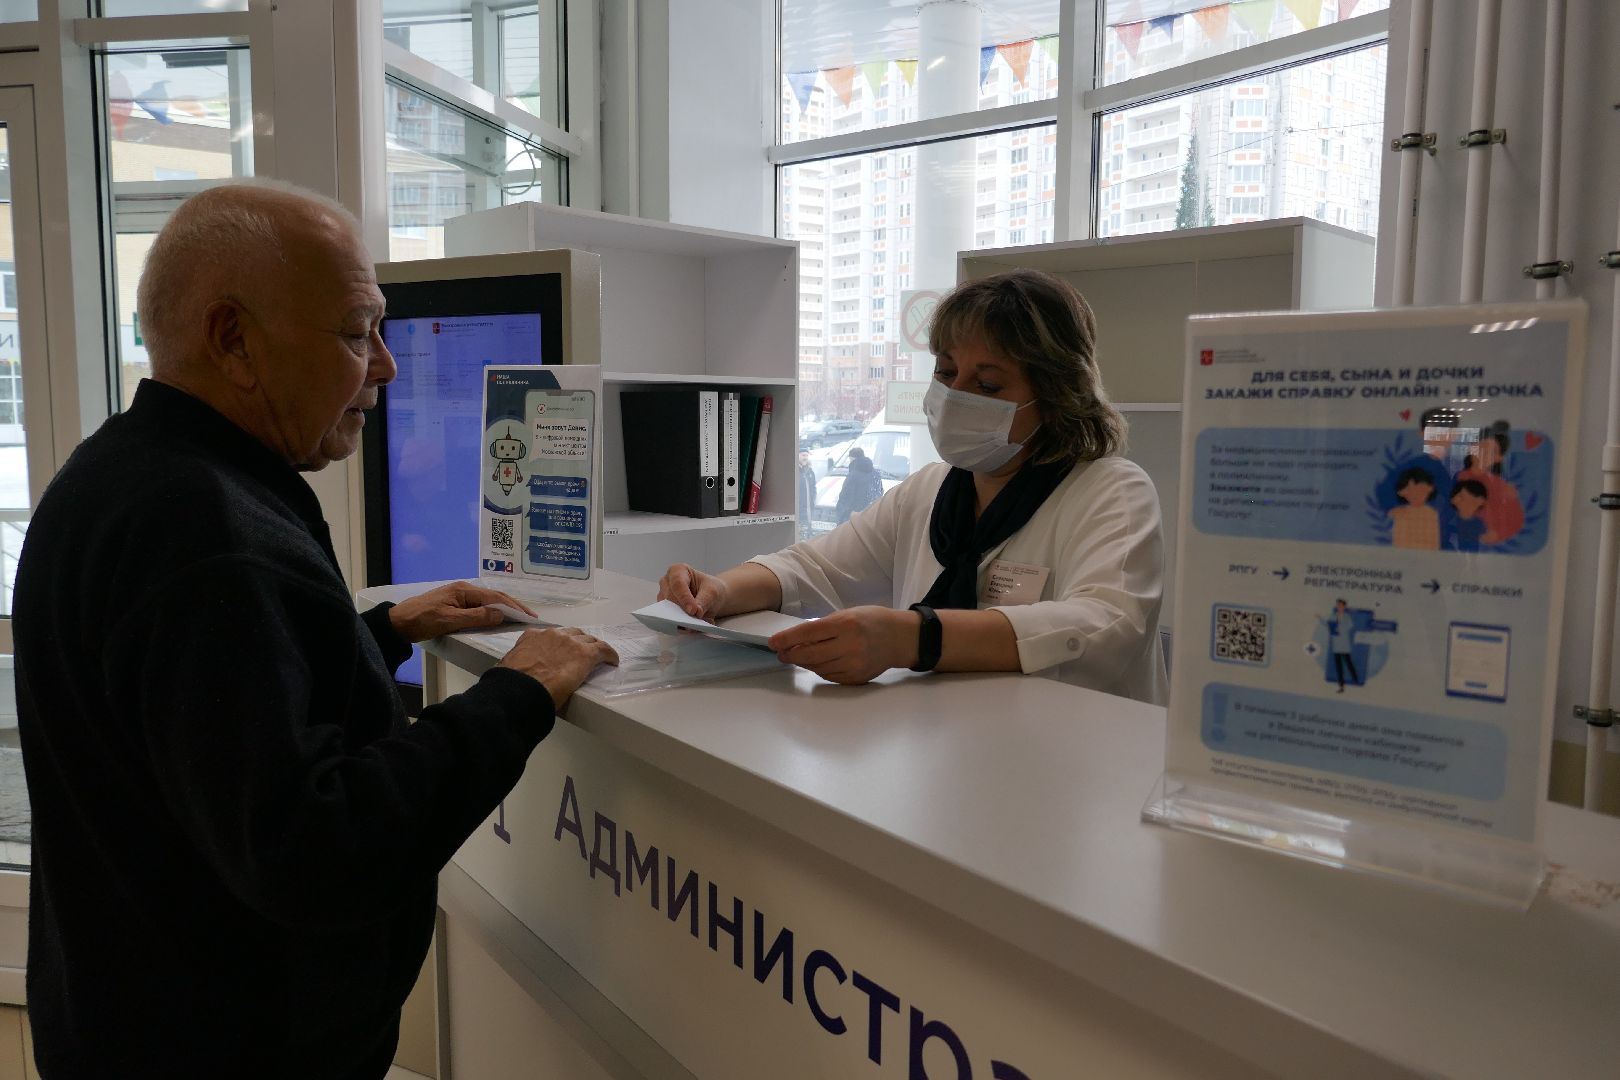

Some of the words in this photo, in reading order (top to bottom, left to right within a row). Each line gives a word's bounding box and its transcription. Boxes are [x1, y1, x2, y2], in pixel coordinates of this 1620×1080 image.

[1251, 370, 1284, 384] ДЛЯ
[1289, 369, 1335, 384] СЕБЯ,
[1339, 368, 1392, 382] СЫНА
[1399, 367, 1411, 380] И
[1415, 365, 1485, 381] ДОЧКИ
[1204, 386, 1274, 400] ЗАКАЖИ
[1277, 385, 1355, 400] СПРАВКУ
[1360, 381, 1439, 398] ОНЛАЙН
[1455, 385, 1468, 397] И
[1477, 383, 1543, 397] ТОЧКА
[1305, 563, 1404, 582] ЭЛЕКТРОННАЯ
[1303, 576, 1405, 595] РЕГИСТРАТУРА
[1451, 582, 1524, 598] СПРАВКИ
[554, 774, 1033, 1080] Администр
